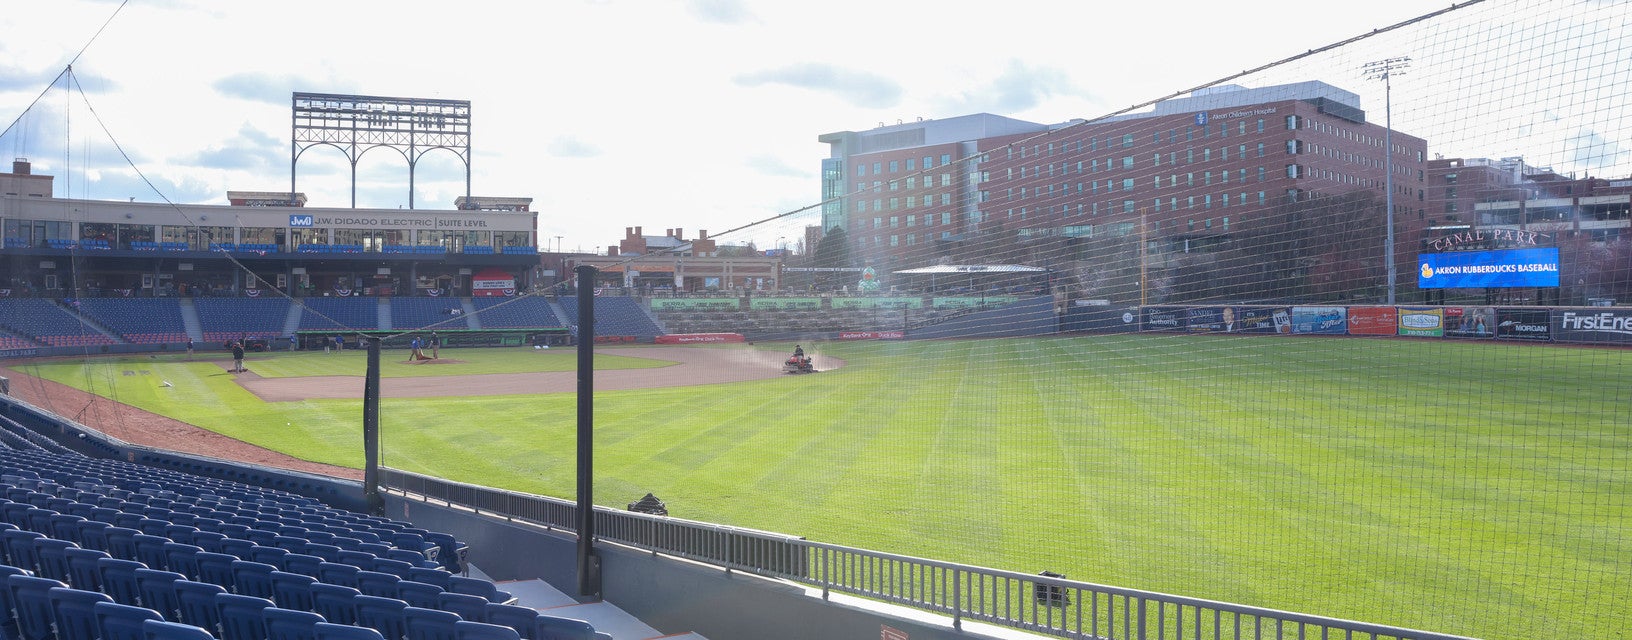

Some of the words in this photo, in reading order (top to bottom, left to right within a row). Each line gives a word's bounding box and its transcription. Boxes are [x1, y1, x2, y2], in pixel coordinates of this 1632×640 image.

[1228, 110, 1253, 119] Children's
[1254, 107, 1276, 116] Hospital
[335, 218, 378, 226] DIDADO
[438, 219, 461, 227] SUITE
[1434, 230, 1484, 250] CANAL
[1494, 229, 1538, 245] PARK
[1435, 265, 1461, 274] AKRON
[1463, 264, 1516, 273] RUBBERDUCKS
[1518, 263, 1557, 272] BASEBALL
